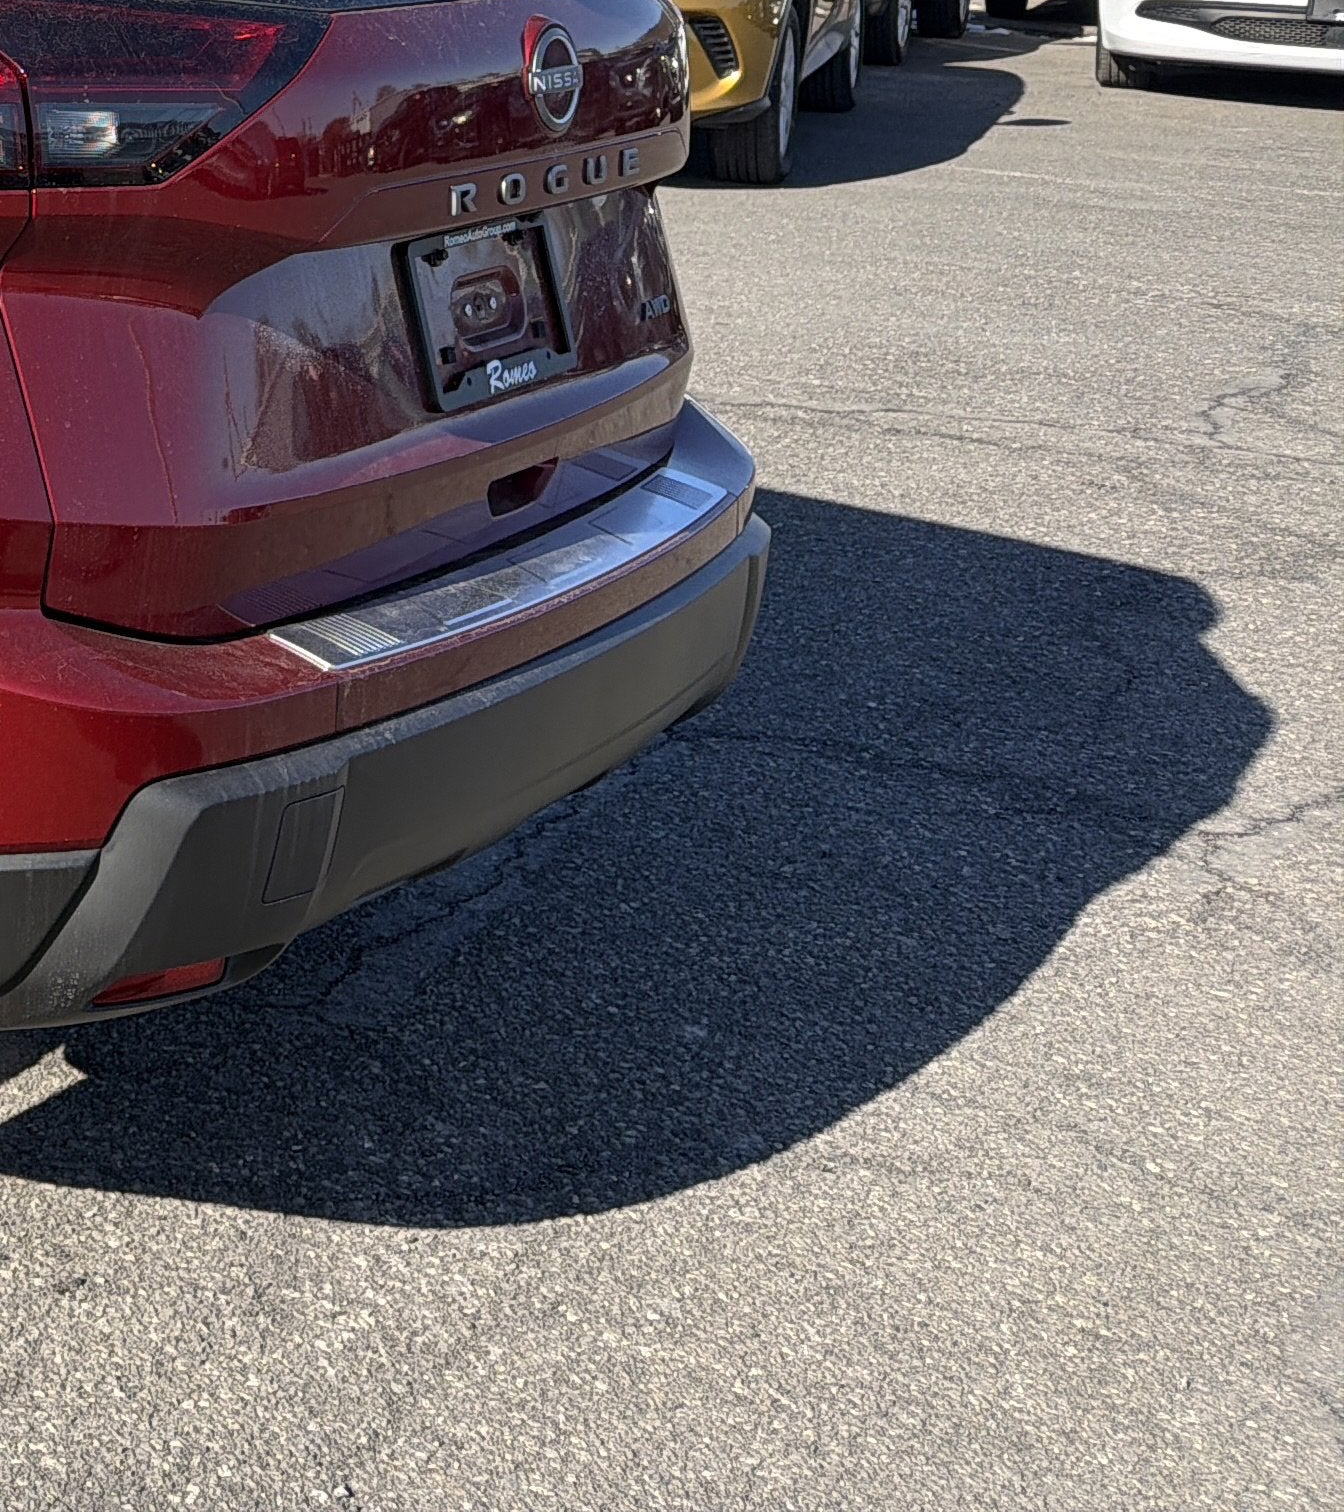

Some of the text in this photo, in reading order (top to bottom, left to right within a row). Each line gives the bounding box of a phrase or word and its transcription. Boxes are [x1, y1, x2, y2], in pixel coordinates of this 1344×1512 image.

[533, 70, 580, 92] NISSA
[449, 147, 642, 217] ROGUE
[642, 294, 671, 321] AWD
[486, 359, 537, 394] Romeo
